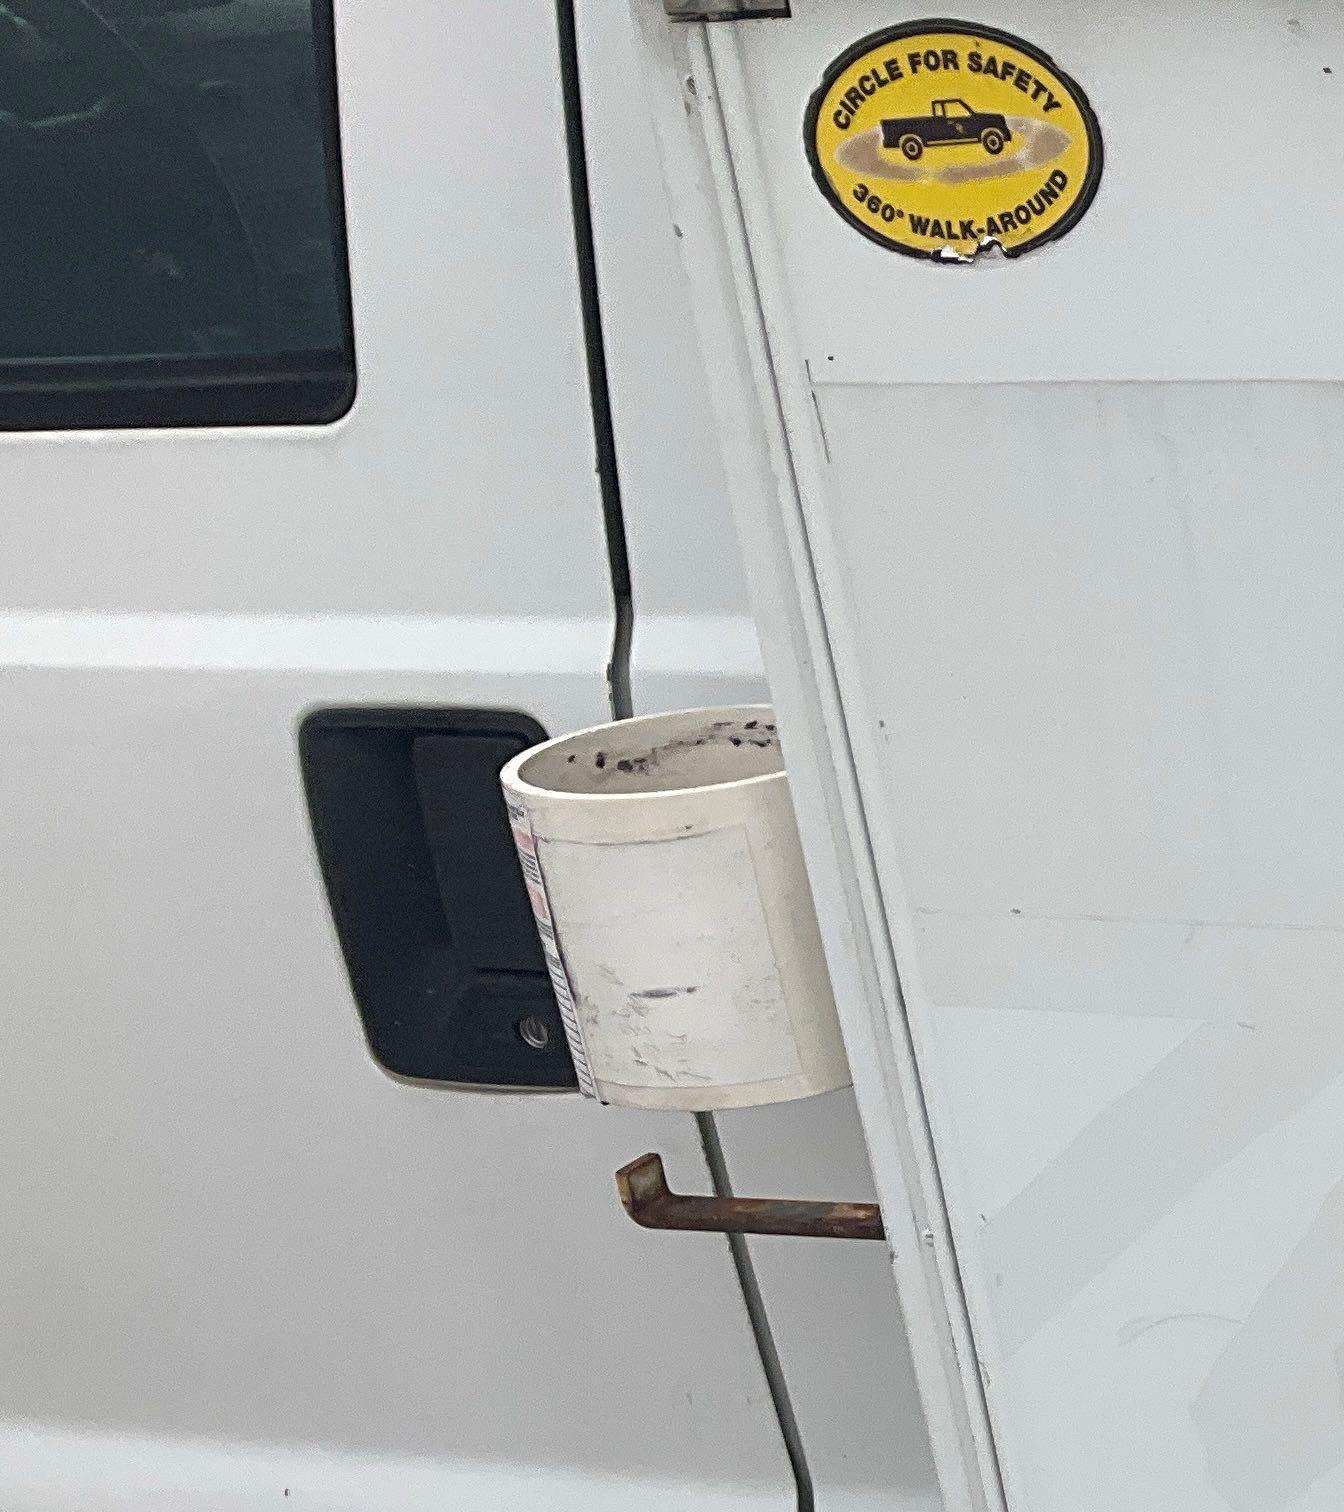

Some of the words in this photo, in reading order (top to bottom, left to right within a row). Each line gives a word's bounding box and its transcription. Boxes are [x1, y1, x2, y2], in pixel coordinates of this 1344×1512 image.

[832, 60, 904, 130] CIRCLE
[908, 49, 960, 74] FOR
[967, 51, 1062, 113] SAFETY
[852, 183, 905, 223] 360°
[908, 168, 1069, 241] WALK-AROUND
